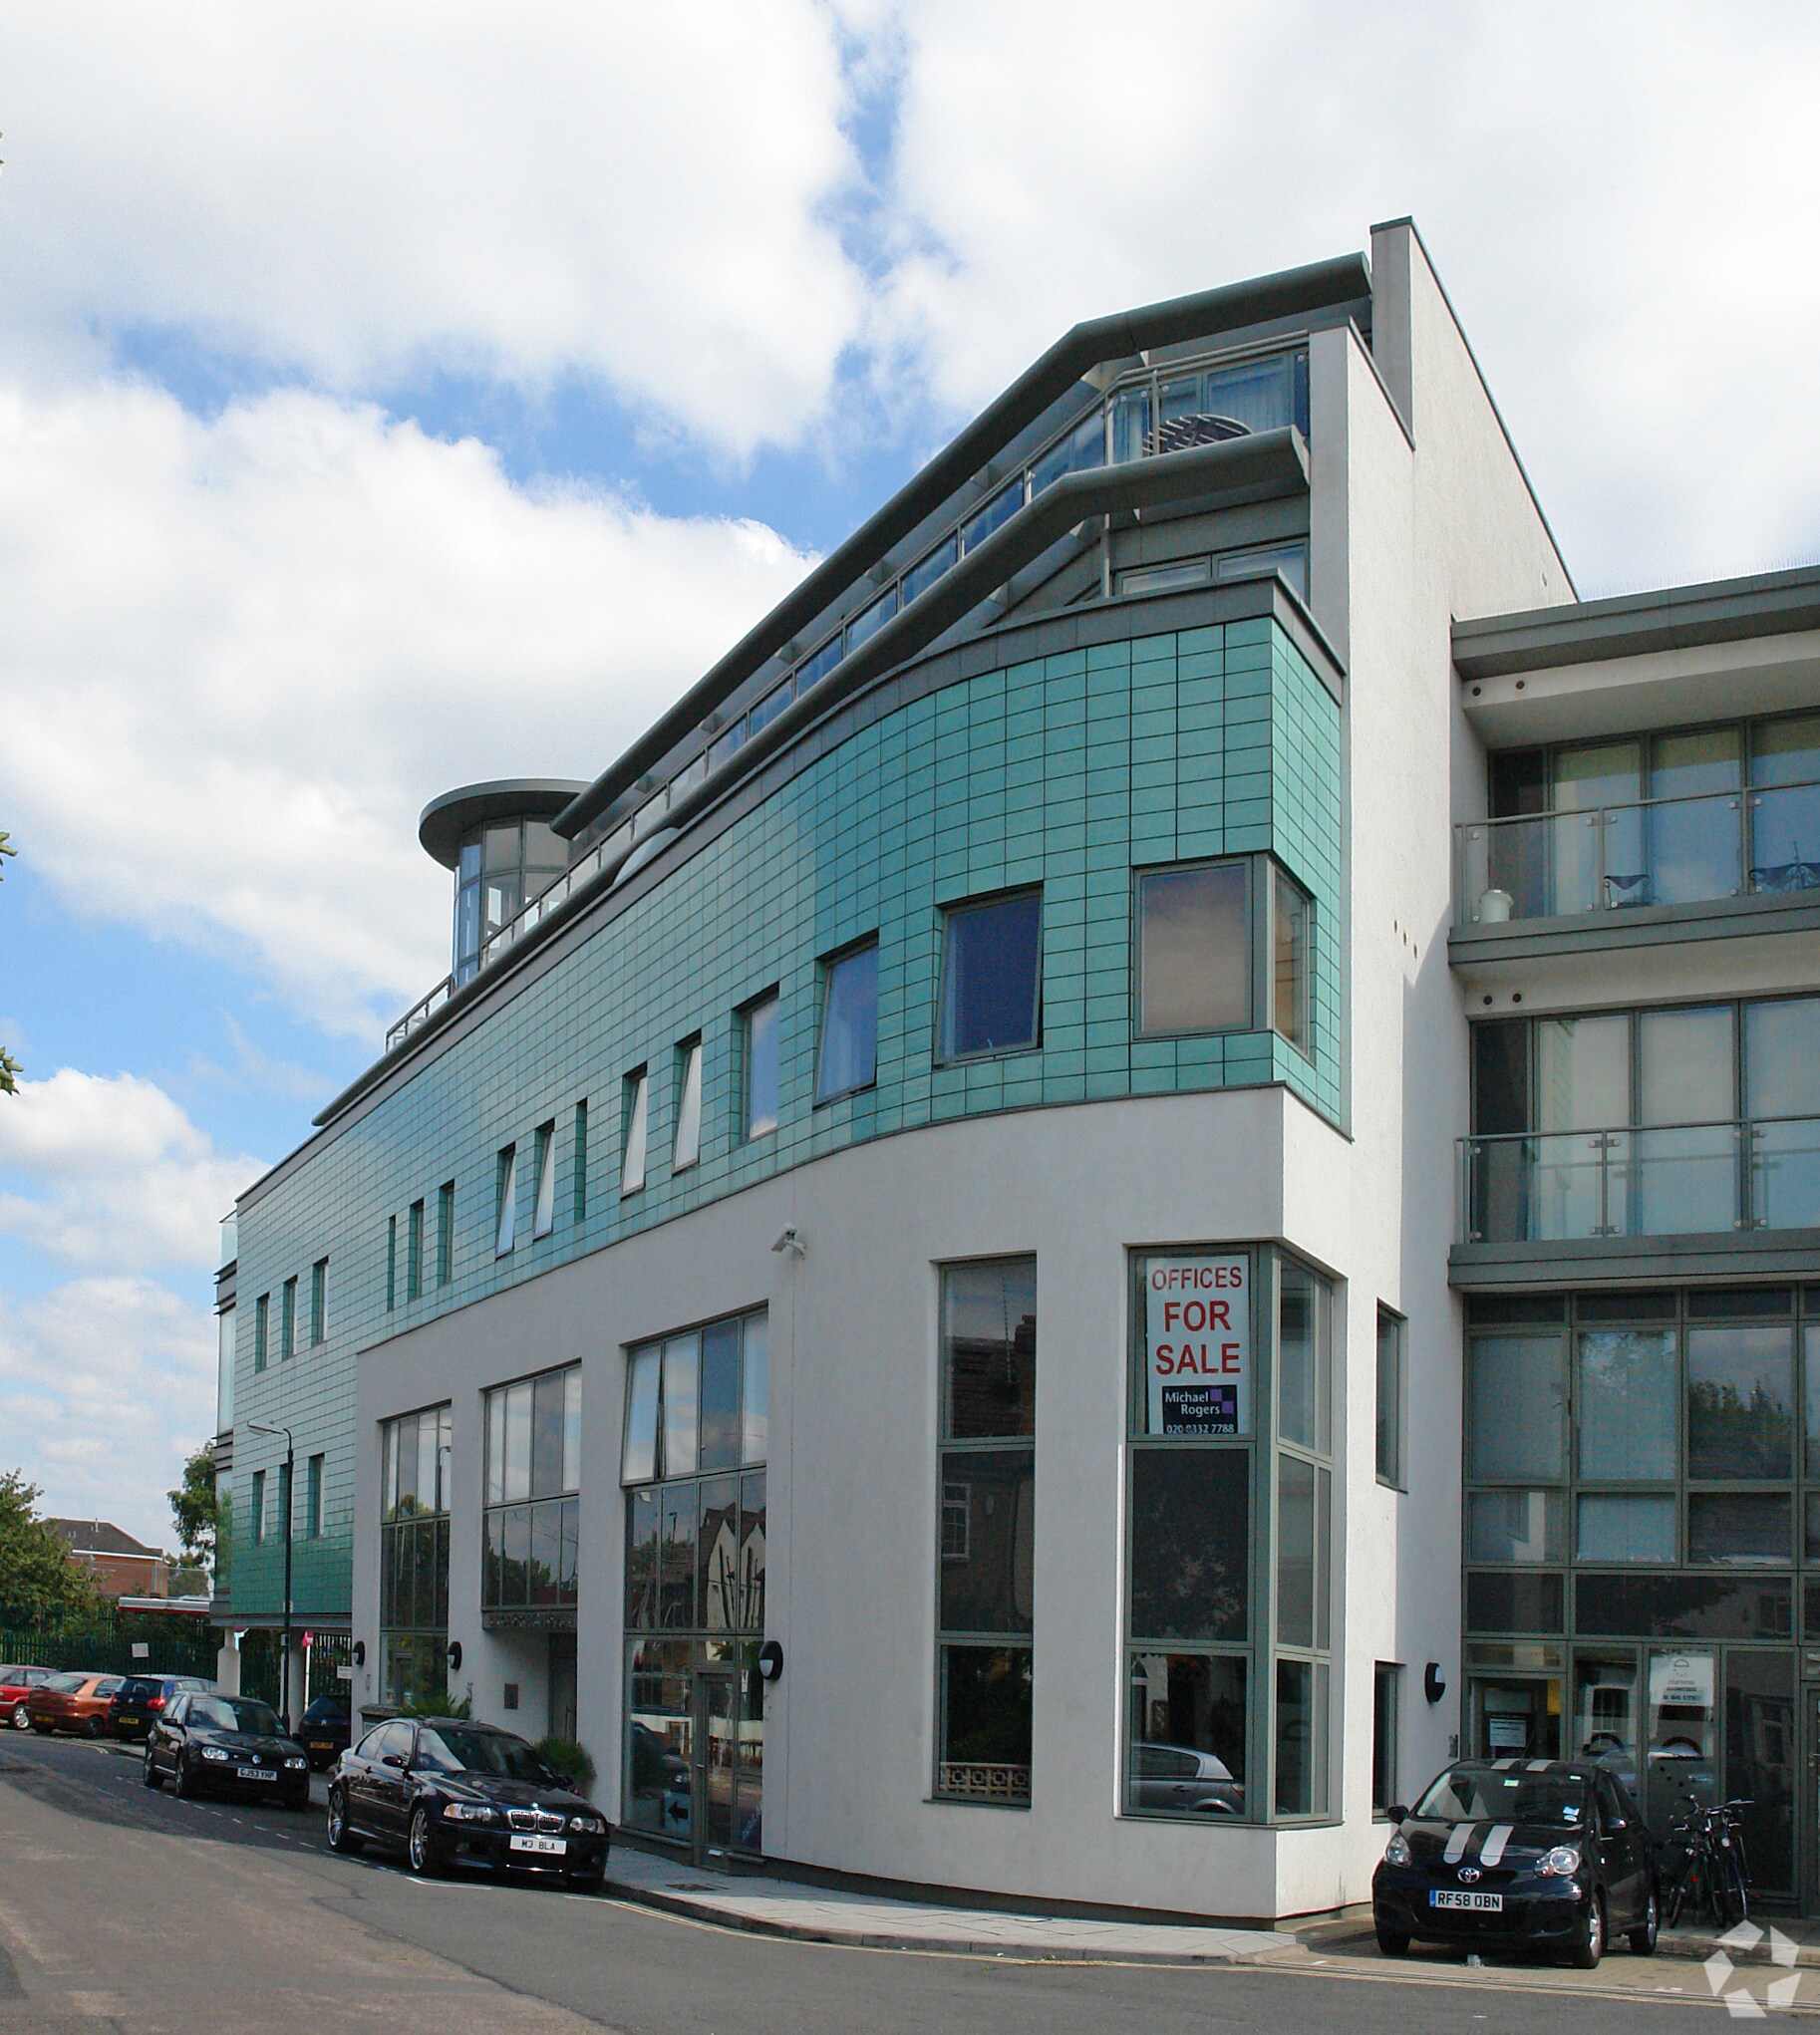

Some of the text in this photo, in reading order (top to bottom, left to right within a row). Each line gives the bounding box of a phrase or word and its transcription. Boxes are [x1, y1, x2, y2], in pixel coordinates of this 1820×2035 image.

[1151, 1267, 1243, 1291] OFFICES
[1164, 1301, 1231, 1331] FOR
[1155, 1343, 1241, 1374] SALE
[1165, 1391, 1209, 1403] Michael
[1181, 1404, 1220, 1418] Rogers
[1166, 1424, 1183, 1433] 020
[1211, 1423, 1235, 1433] 7788
[521, 1840, 555, 1850] M3 BLA
[1437, 1892, 1500, 1908] RF58 OBN
